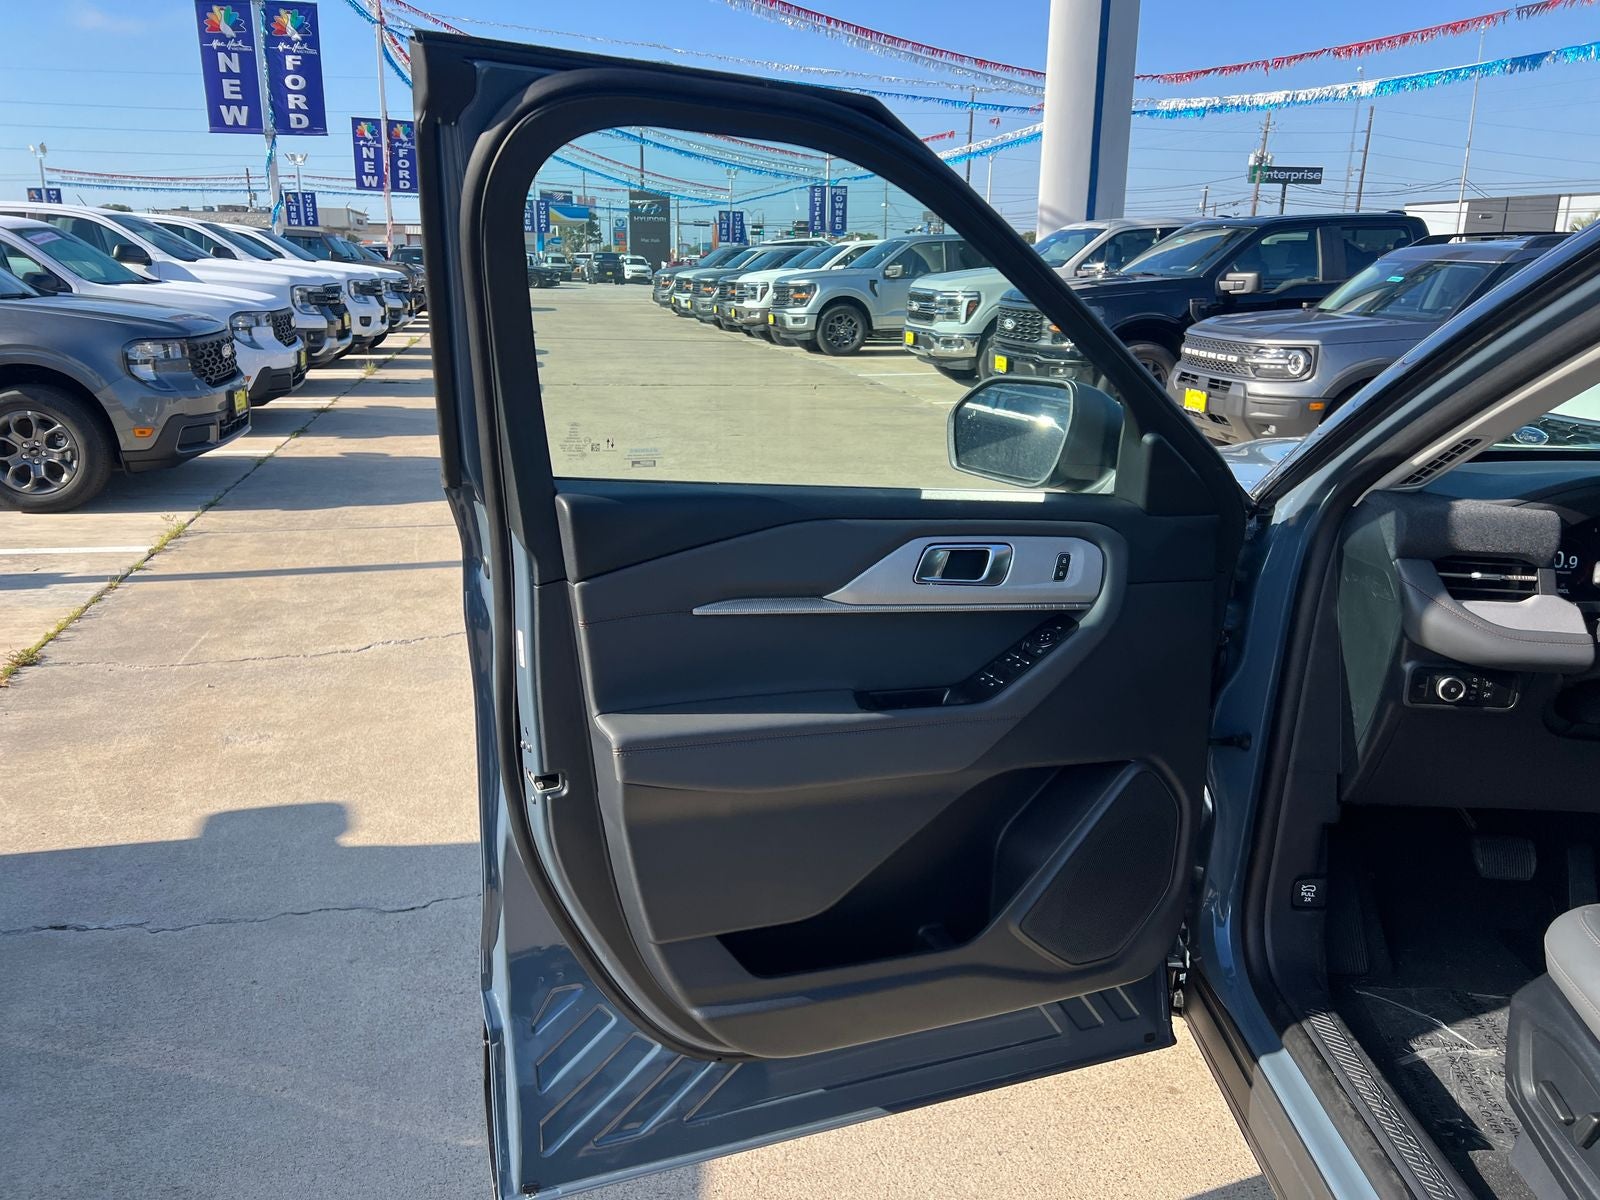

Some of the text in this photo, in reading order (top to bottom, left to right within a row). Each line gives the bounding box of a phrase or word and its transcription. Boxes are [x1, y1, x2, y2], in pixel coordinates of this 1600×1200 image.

[217, 51, 249, 126] NEW
[284, 55, 309, 129] FORD
[362, 147, 378, 187] NEW
[397, 149, 410, 189] FORD
[1262, 169, 1322, 182] nterprise
[290, 206, 298, 225] NEW
[305, 194, 313, 225] HYUNDAI
[835, 196, 844, 230] OWNED
[1184, 347, 1238, 363] BRONCO
